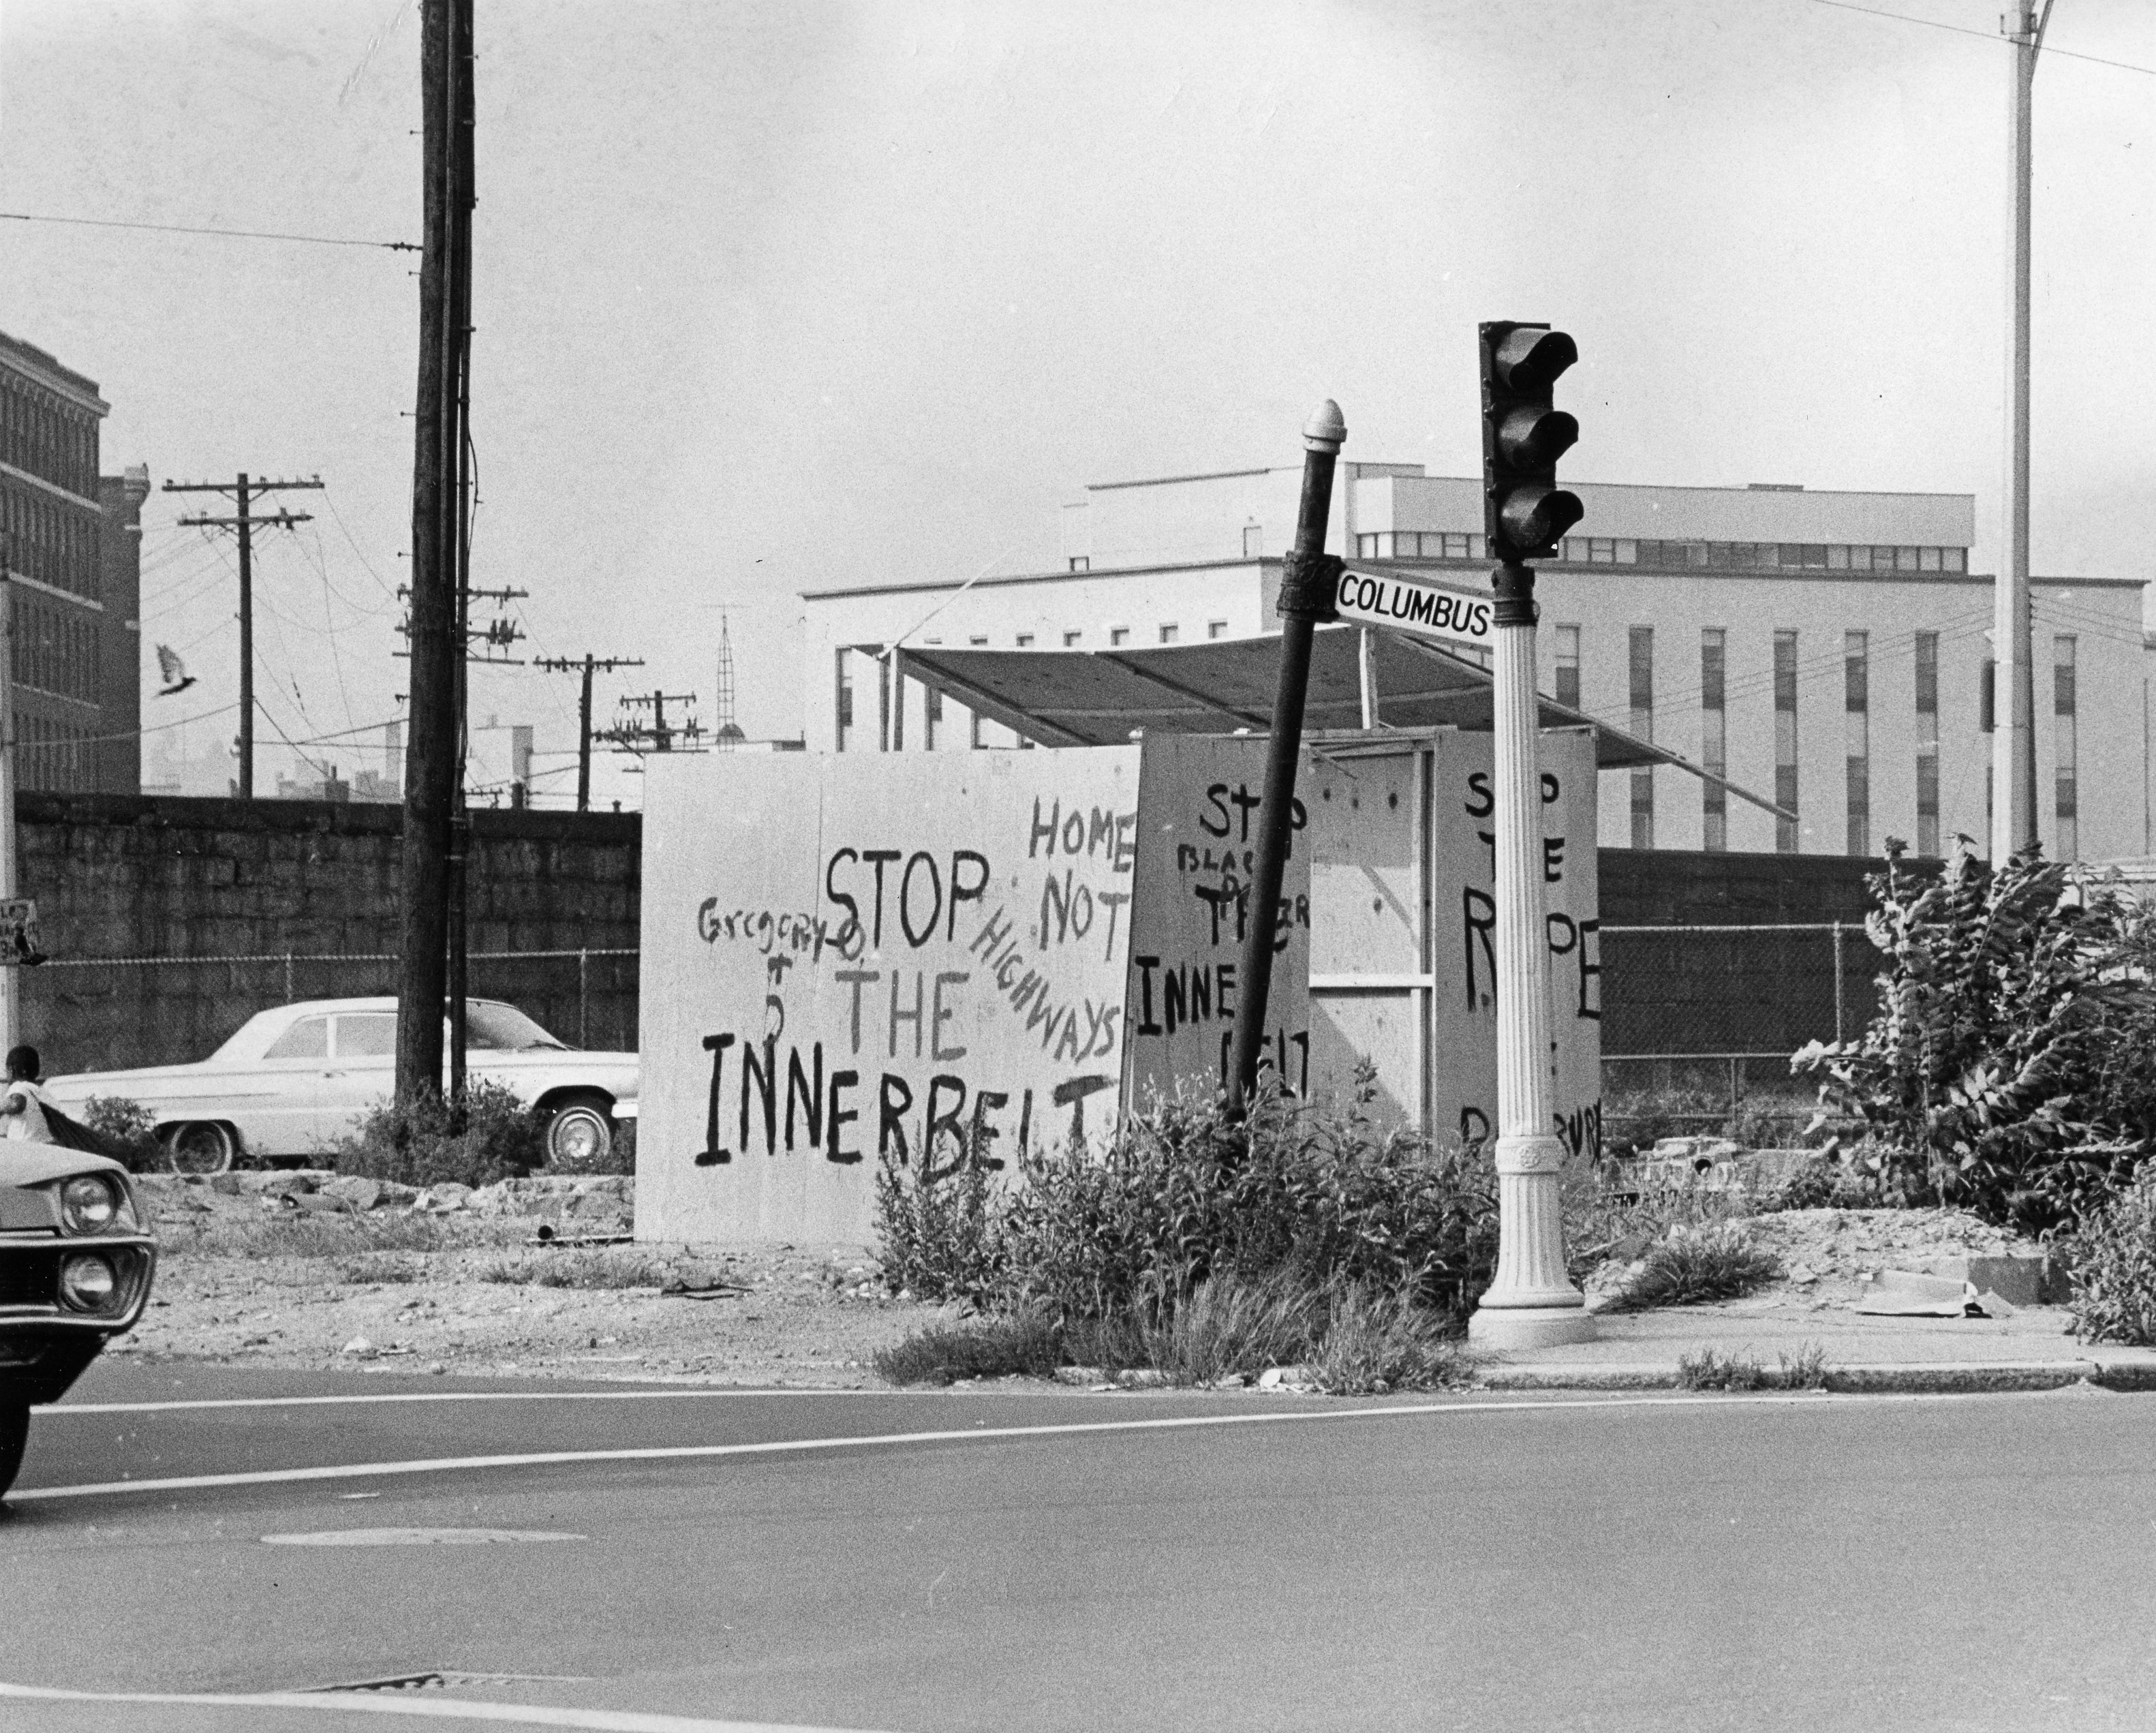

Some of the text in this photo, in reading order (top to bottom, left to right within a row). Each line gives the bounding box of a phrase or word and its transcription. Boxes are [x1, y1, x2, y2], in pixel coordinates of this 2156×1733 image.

[1339, 574, 1490, 636] COLUMBUS
[1029, 795, 1136, 872] HOME
[1177, 844, 1255, 874] BLAC
[1477, 837, 1565, 883] TE
[826, 847, 990, 949] STOP
[1039, 868, 1130, 962] NOT
[835, 970, 970, 1061] THE
[969, 904, 1120, 1064] HIGHWAYS
[1135, 955, 1237, 1035] INNE
